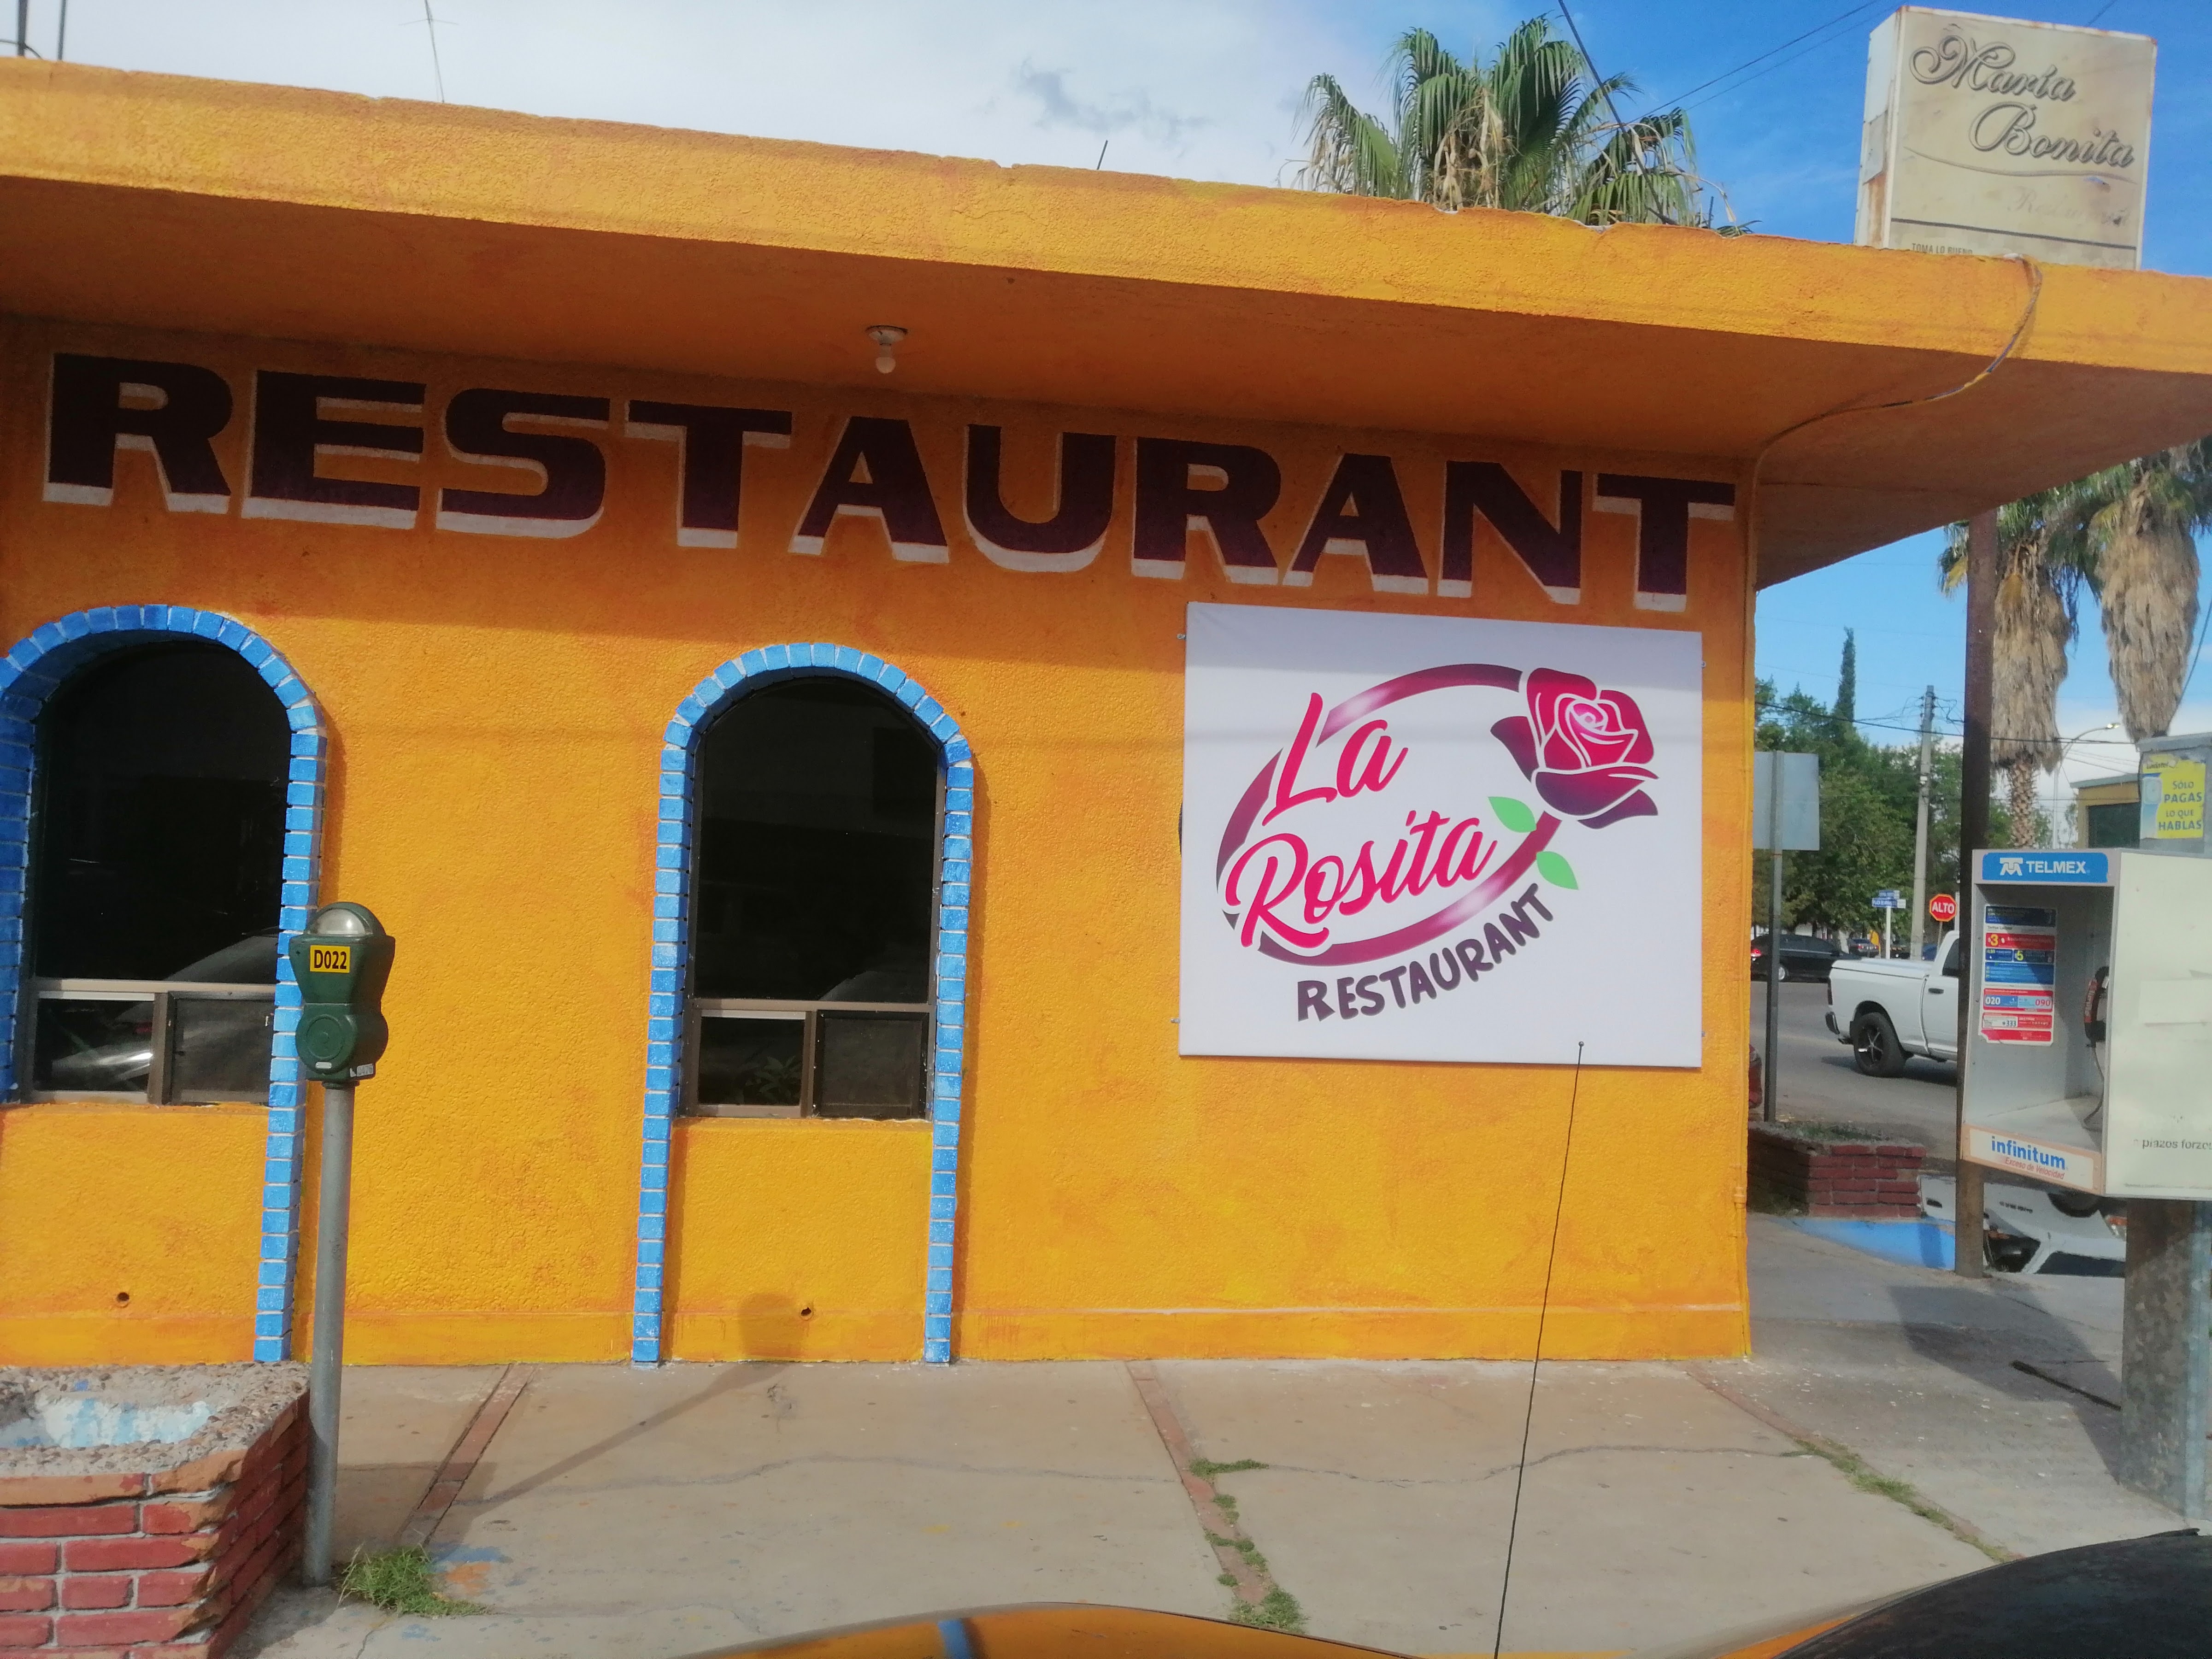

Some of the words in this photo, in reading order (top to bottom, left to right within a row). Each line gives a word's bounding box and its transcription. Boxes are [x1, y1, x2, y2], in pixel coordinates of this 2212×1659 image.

[1969, 101, 2135, 168] Bonita
[1912, 243, 1933, 253] TOMA
[1936, 246, 1945, 254] LO
[42, 353, 1736, 613] RESTAURANT
[1262, 692, 1409, 826] La
[2164, 792, 2202, 803] PAGAS
[2178, 810, 2194, 819] QUE
[2159, 820, 2202, 830] HABLAS
[2026, 860, 2086, 874] TELMEX
[1225, 810, 1498, 948] Rosita
[1932, 901, 1955, 914] ALTO
[314, 950, 347, 970] D022
[1297, 882, 1553, 1022] RESTAURANT
[1986, 997, 2000, 1005] 020
[1992, 1136, 2065, 1170] infinitum
[2005, 1157, 2026, 1169] Exceso
[2027, 1163, 2034, 1171] de
[2036, 1165, 2065, 1180] Velocidad
